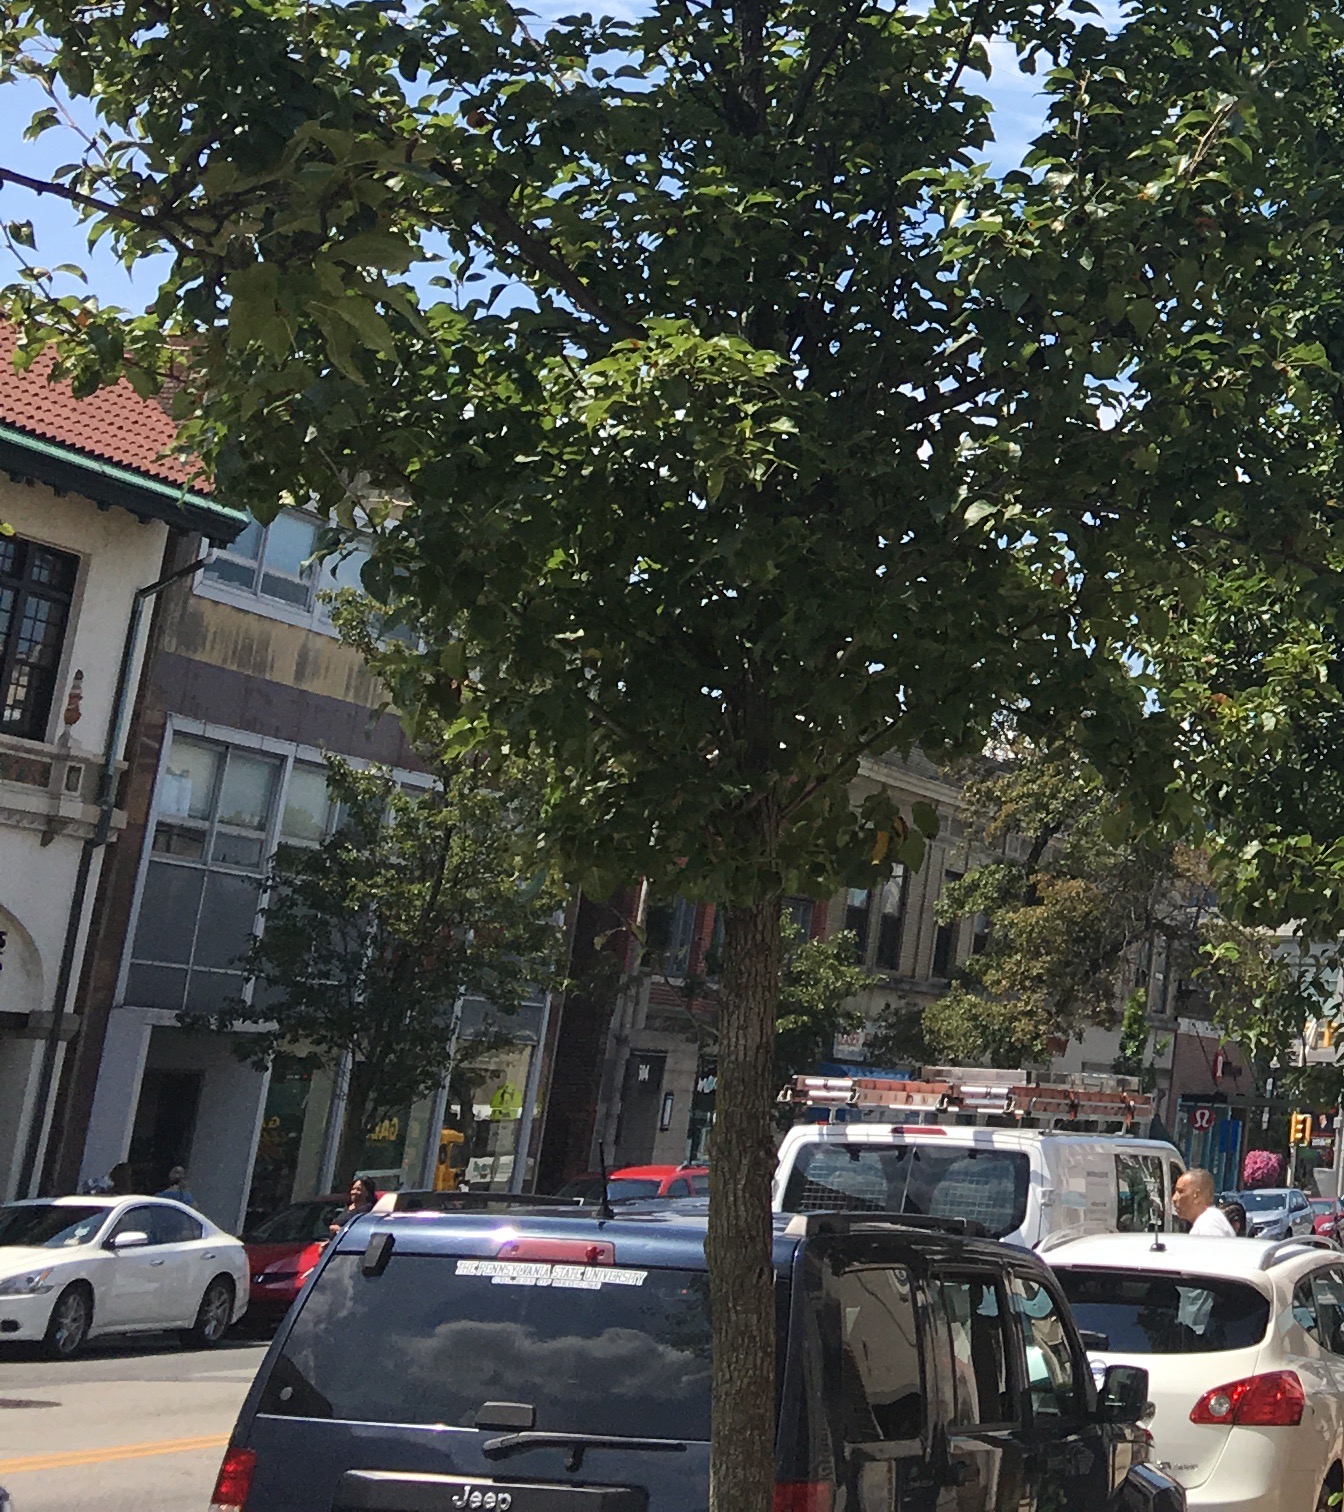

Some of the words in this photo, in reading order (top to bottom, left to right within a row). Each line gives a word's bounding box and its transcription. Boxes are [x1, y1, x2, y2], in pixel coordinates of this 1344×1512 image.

[456, 1261, 477, 1274] THE
[478, 1262, 550, 1278] PENNSYLVANIA
[552, 1265, 583, 1279] STATE
[585, 1267, 648, 1285] UNIVERSITY
[452, 1485, 512, 1512] Jeep
